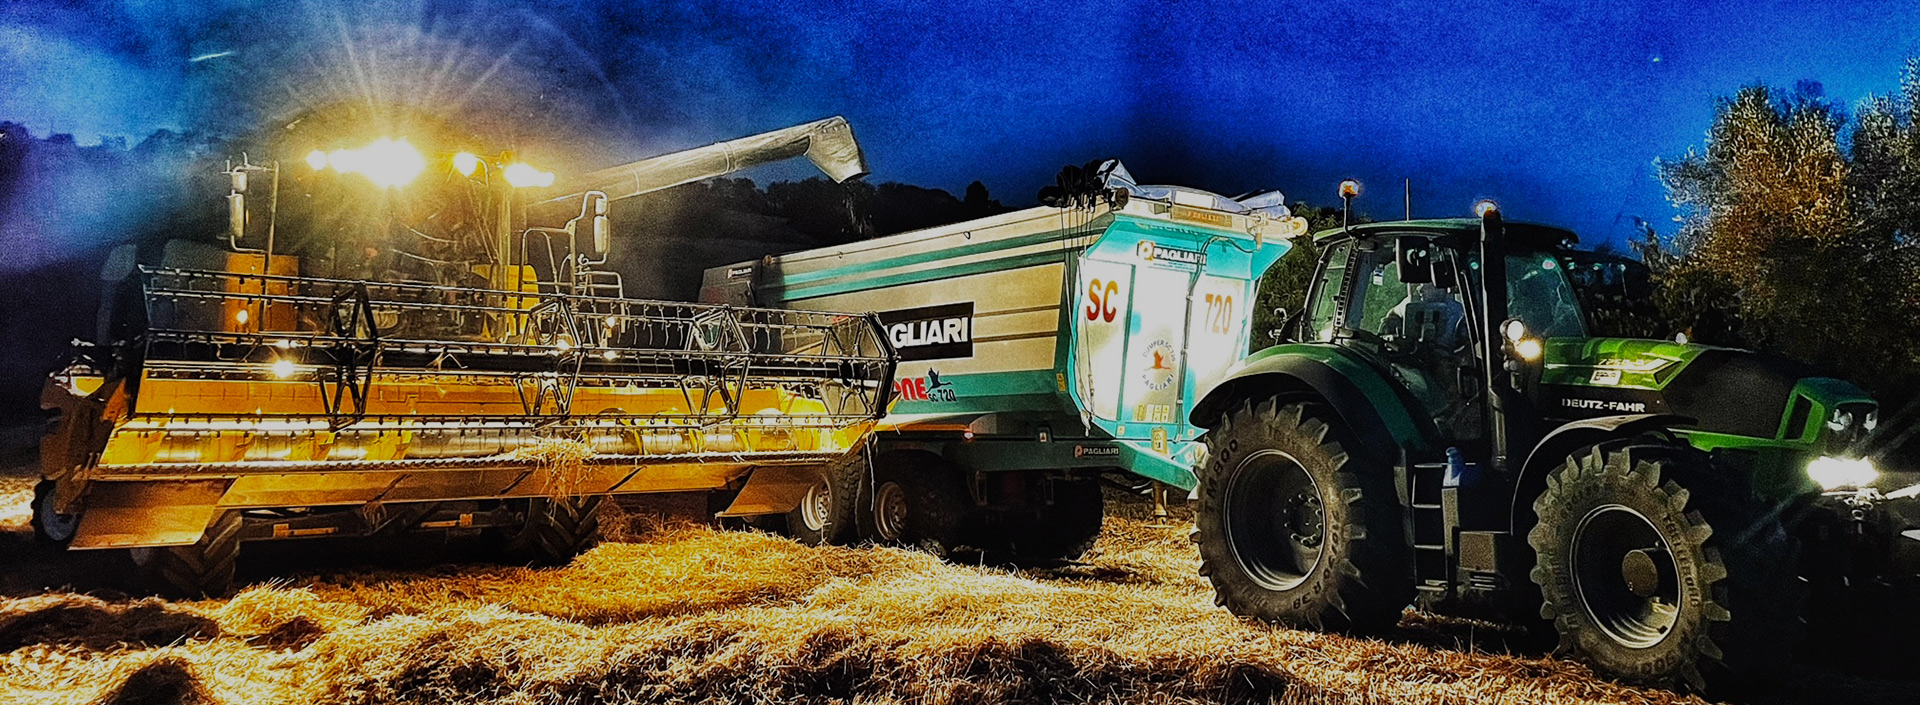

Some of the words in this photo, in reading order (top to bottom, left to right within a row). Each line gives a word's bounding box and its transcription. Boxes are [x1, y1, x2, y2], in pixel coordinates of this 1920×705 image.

[1086, 278, 1119, 323] SC
[1204, 293, 1233, 335] 720
[884, 317, 969, 349] GLIARI
[937, 388, 957, 402] 720
[1142, 373, 1175, 392] PAGLIARI
[1561, 398, 1646, 413] DEUTZ-FAHR
[1083, 447, 1119, 455] PAGLIARI
[1213, 438, 1239, 476] 800
